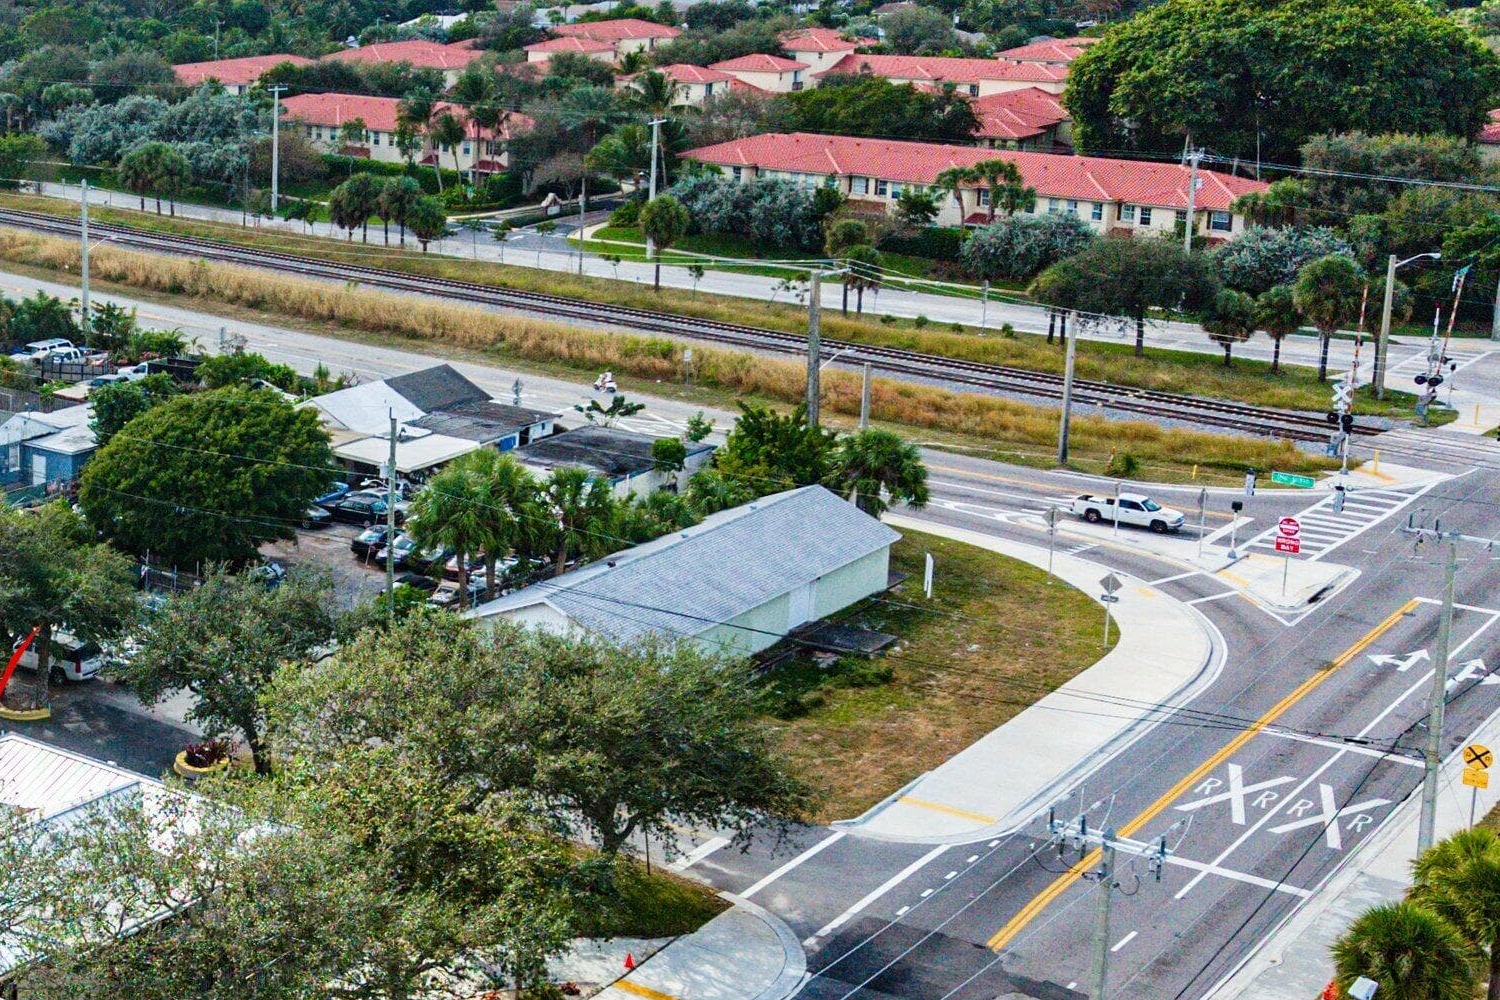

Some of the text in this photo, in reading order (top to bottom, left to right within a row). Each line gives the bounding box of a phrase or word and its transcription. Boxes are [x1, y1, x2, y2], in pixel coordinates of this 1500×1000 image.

[1194, 777, 1223, 795] R
[1251, 790, 1279, 809] R
[1286, 799, 1314, 817] R
[1346, 813, 1374, 833] R
